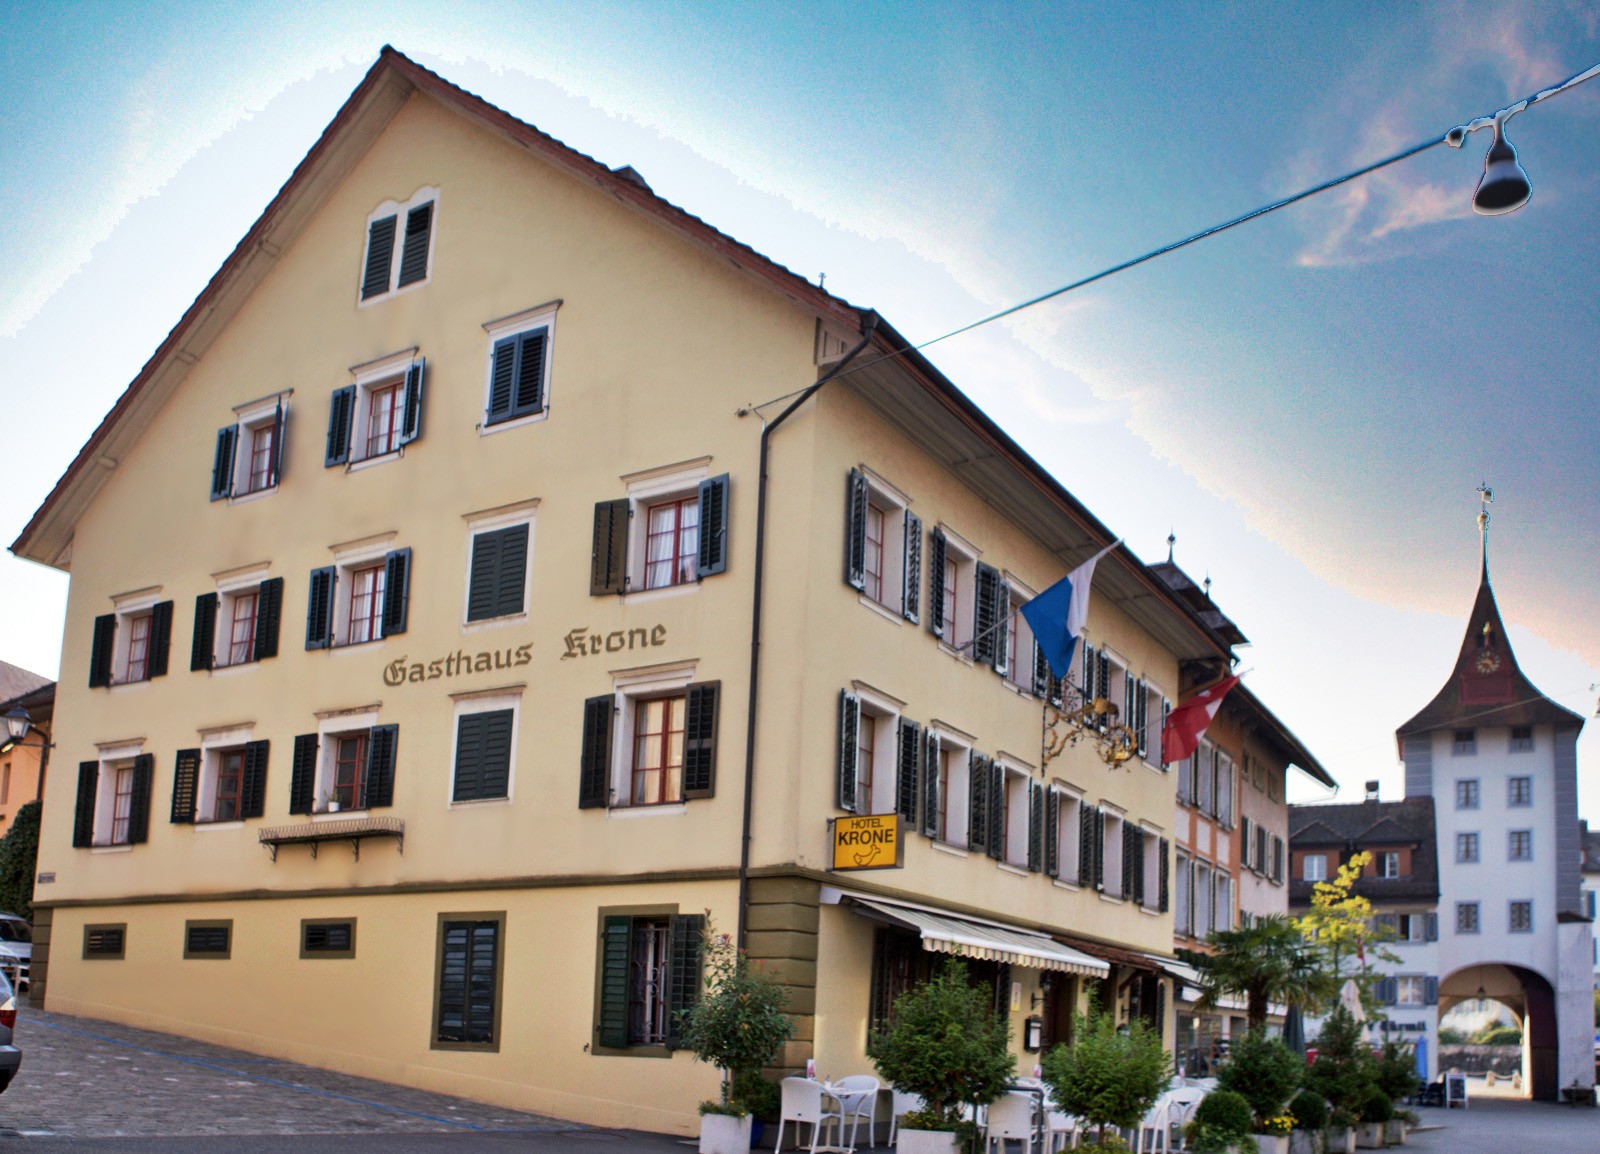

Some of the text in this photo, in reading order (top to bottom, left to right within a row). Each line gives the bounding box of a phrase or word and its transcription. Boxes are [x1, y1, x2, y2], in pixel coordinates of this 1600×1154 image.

[383, 623, 667, 687] Gasthaus Krone
[851, 818, 883, 829] HOTEL
[838, 829, 894, 846] KRONE
